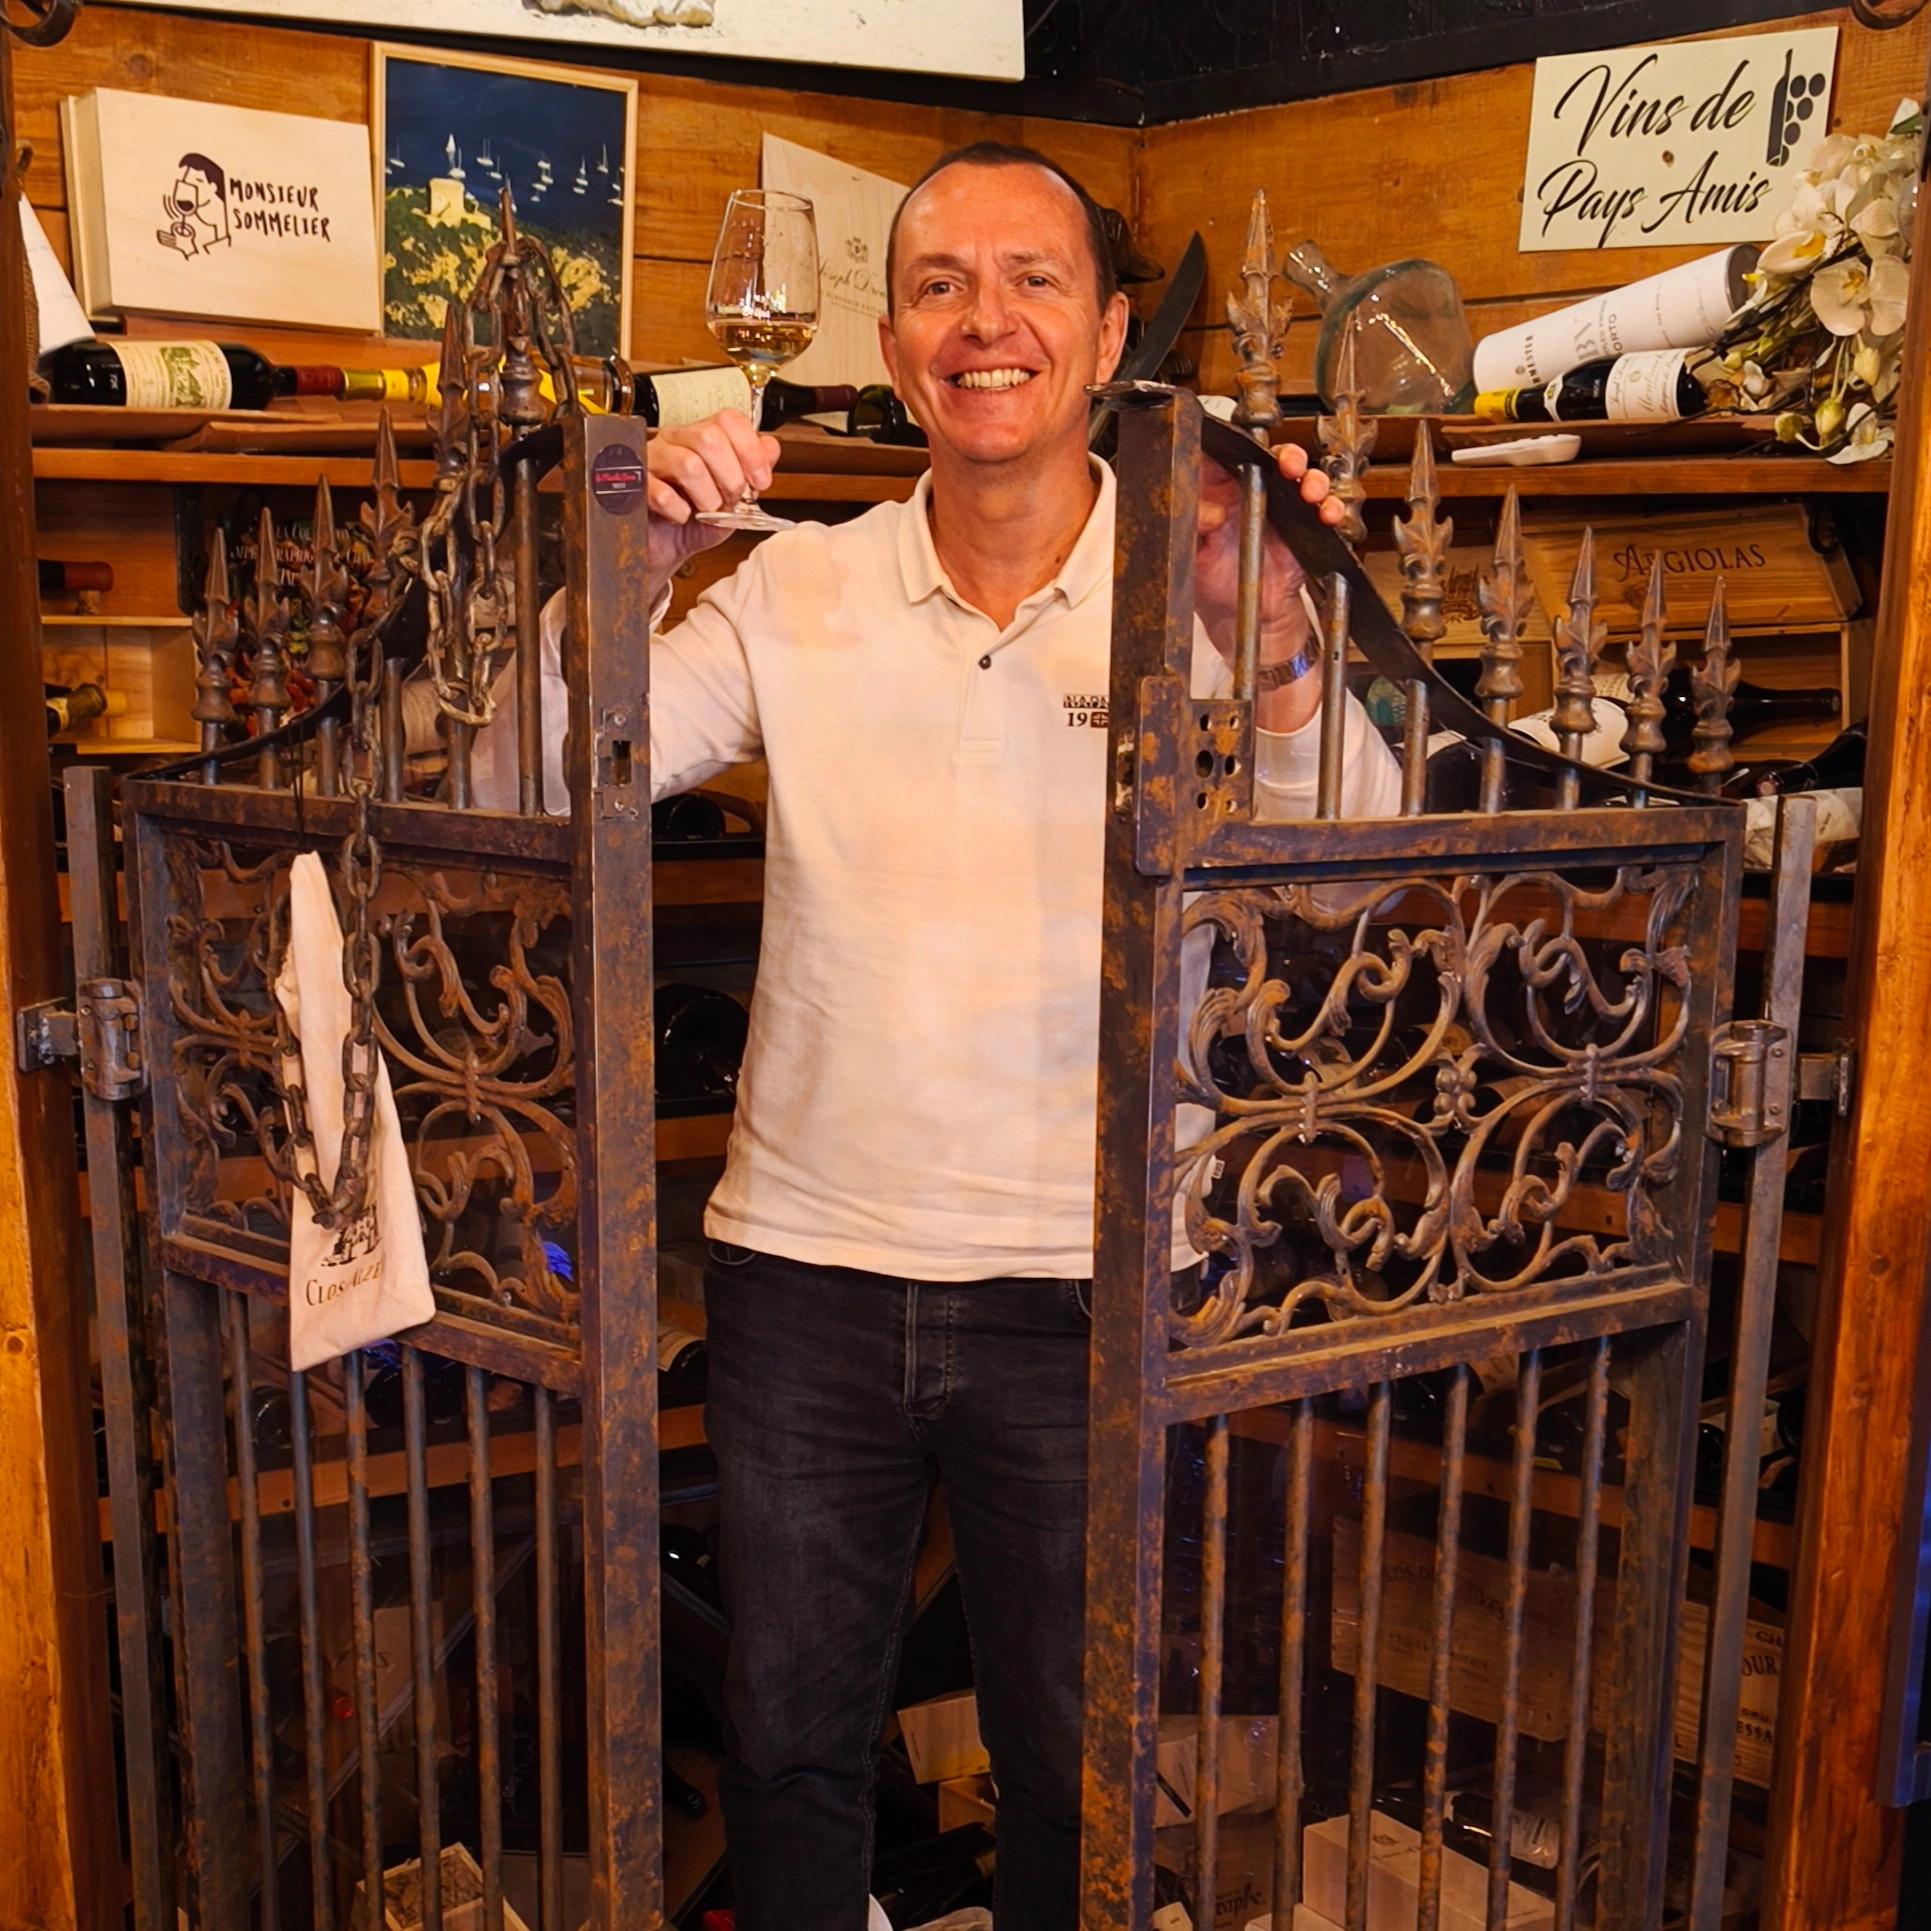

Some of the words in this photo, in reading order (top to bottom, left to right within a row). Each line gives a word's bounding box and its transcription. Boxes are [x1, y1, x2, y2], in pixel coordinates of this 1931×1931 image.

[1553, 53, 1689, 157] Vins
[1690, 59, 1757, 133] de
[229, 177, 319, 212] MONSIEUR
[1537, 159, 1647, 249] Pays
[1640, 150, 1773, 233] Amis
[232, 207, 331, 243] SOMMELIER
[1607, 313, 1624, 354] ORTO
